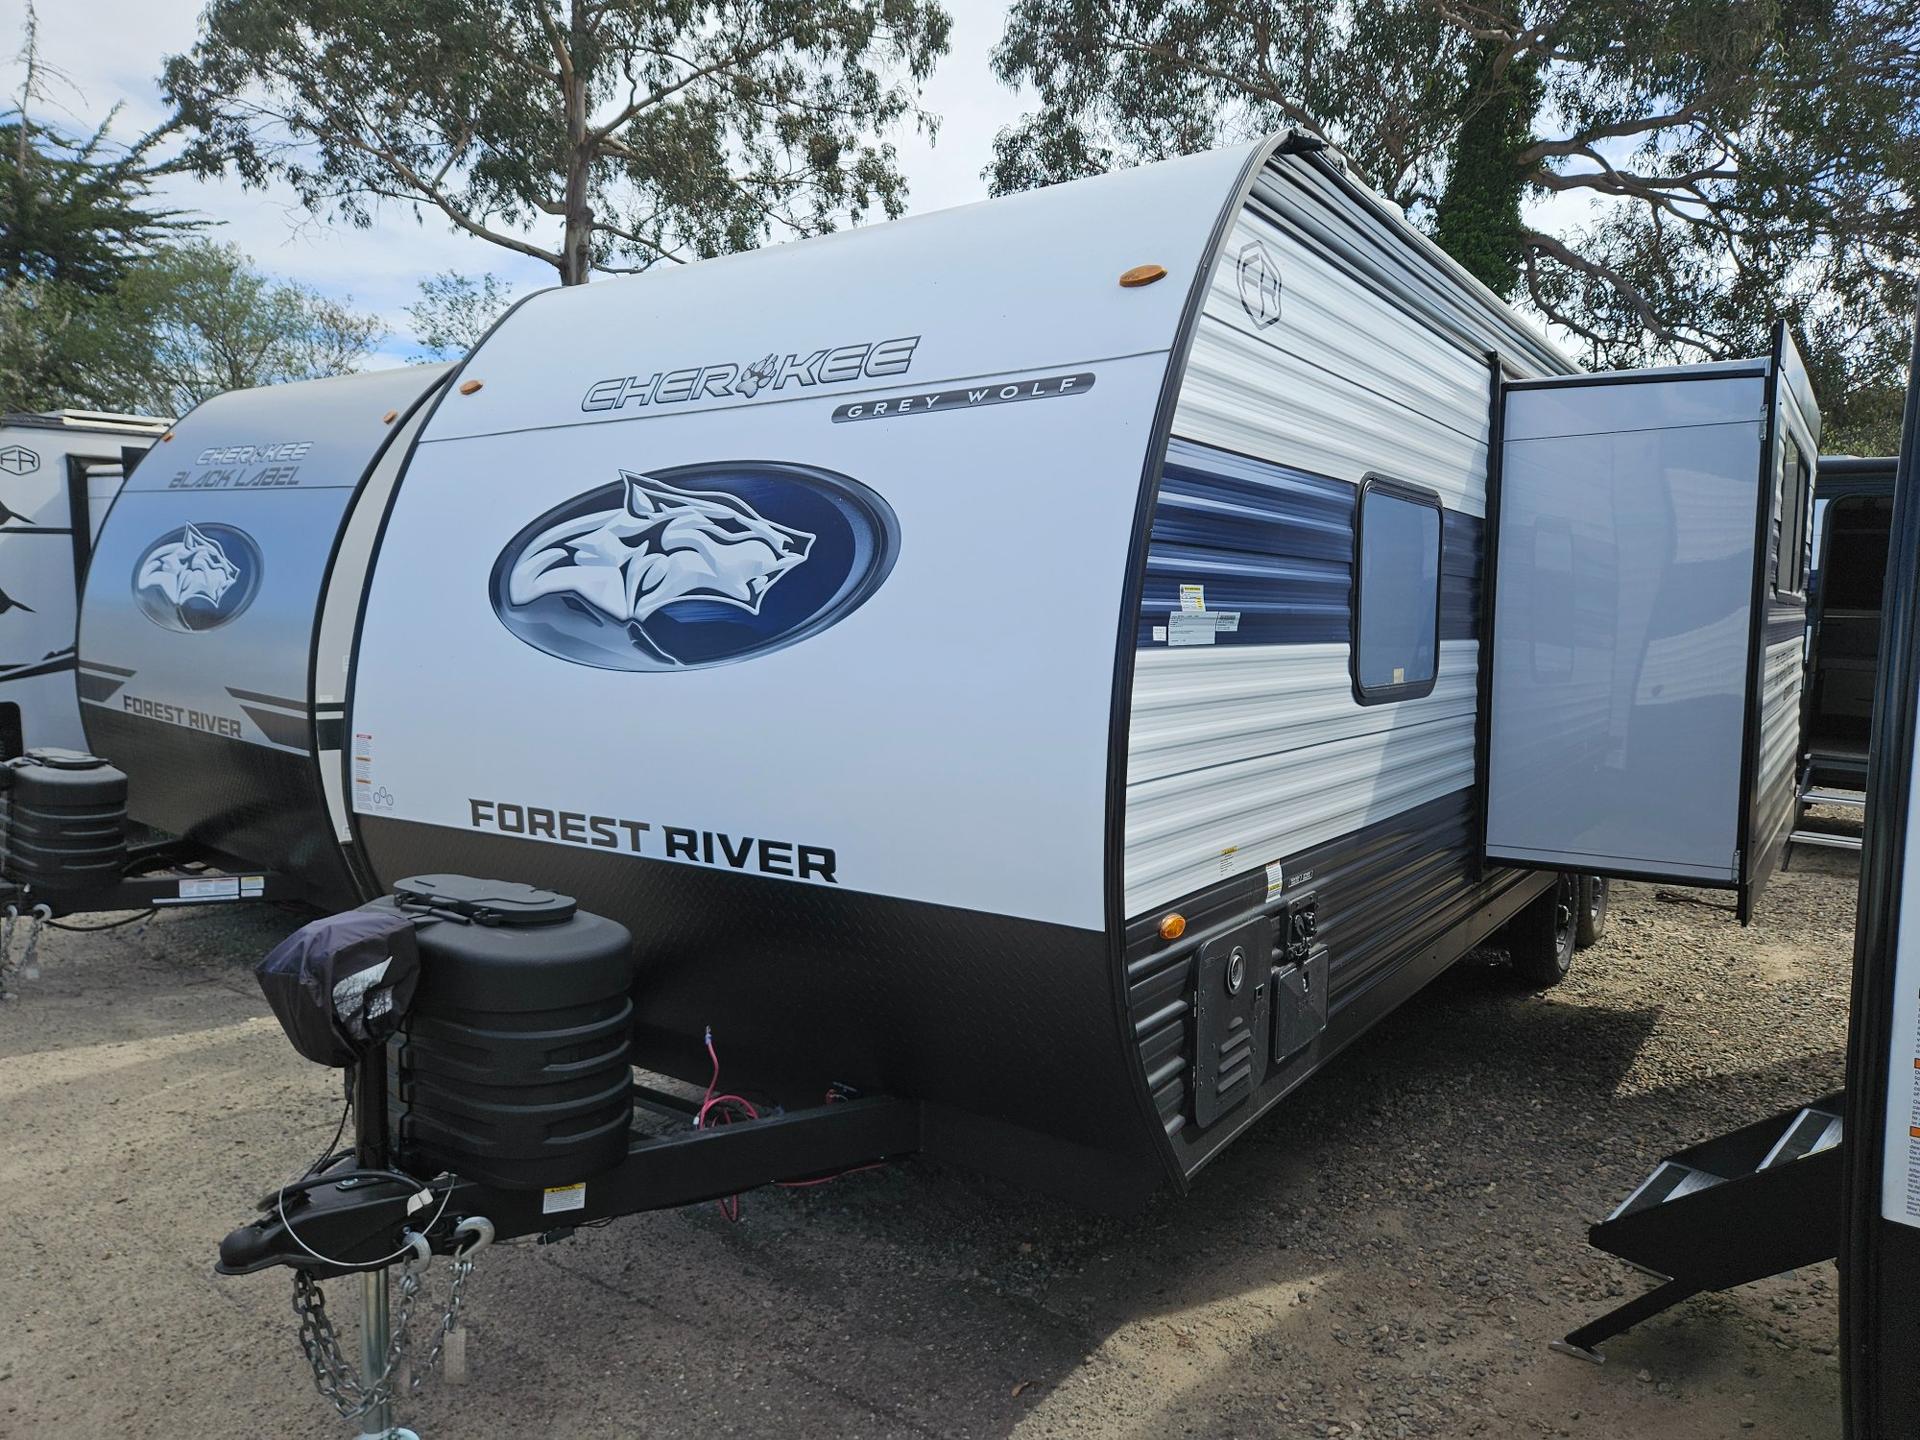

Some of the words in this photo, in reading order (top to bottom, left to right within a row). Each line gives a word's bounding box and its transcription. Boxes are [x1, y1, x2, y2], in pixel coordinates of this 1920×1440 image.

[846, 394, 942, 419] GREY
[967, 377, 1079, 404] WOLF
[168, 469, 237, 489] BLACK
[233, 466, 301, 487] LABEL
[122, 694, 184, 724] FOREST
[188, 709, 242, 738] RIVER
[468, 798, 650, 852] FOREST
[662, 825, 839, 884] RIVER
